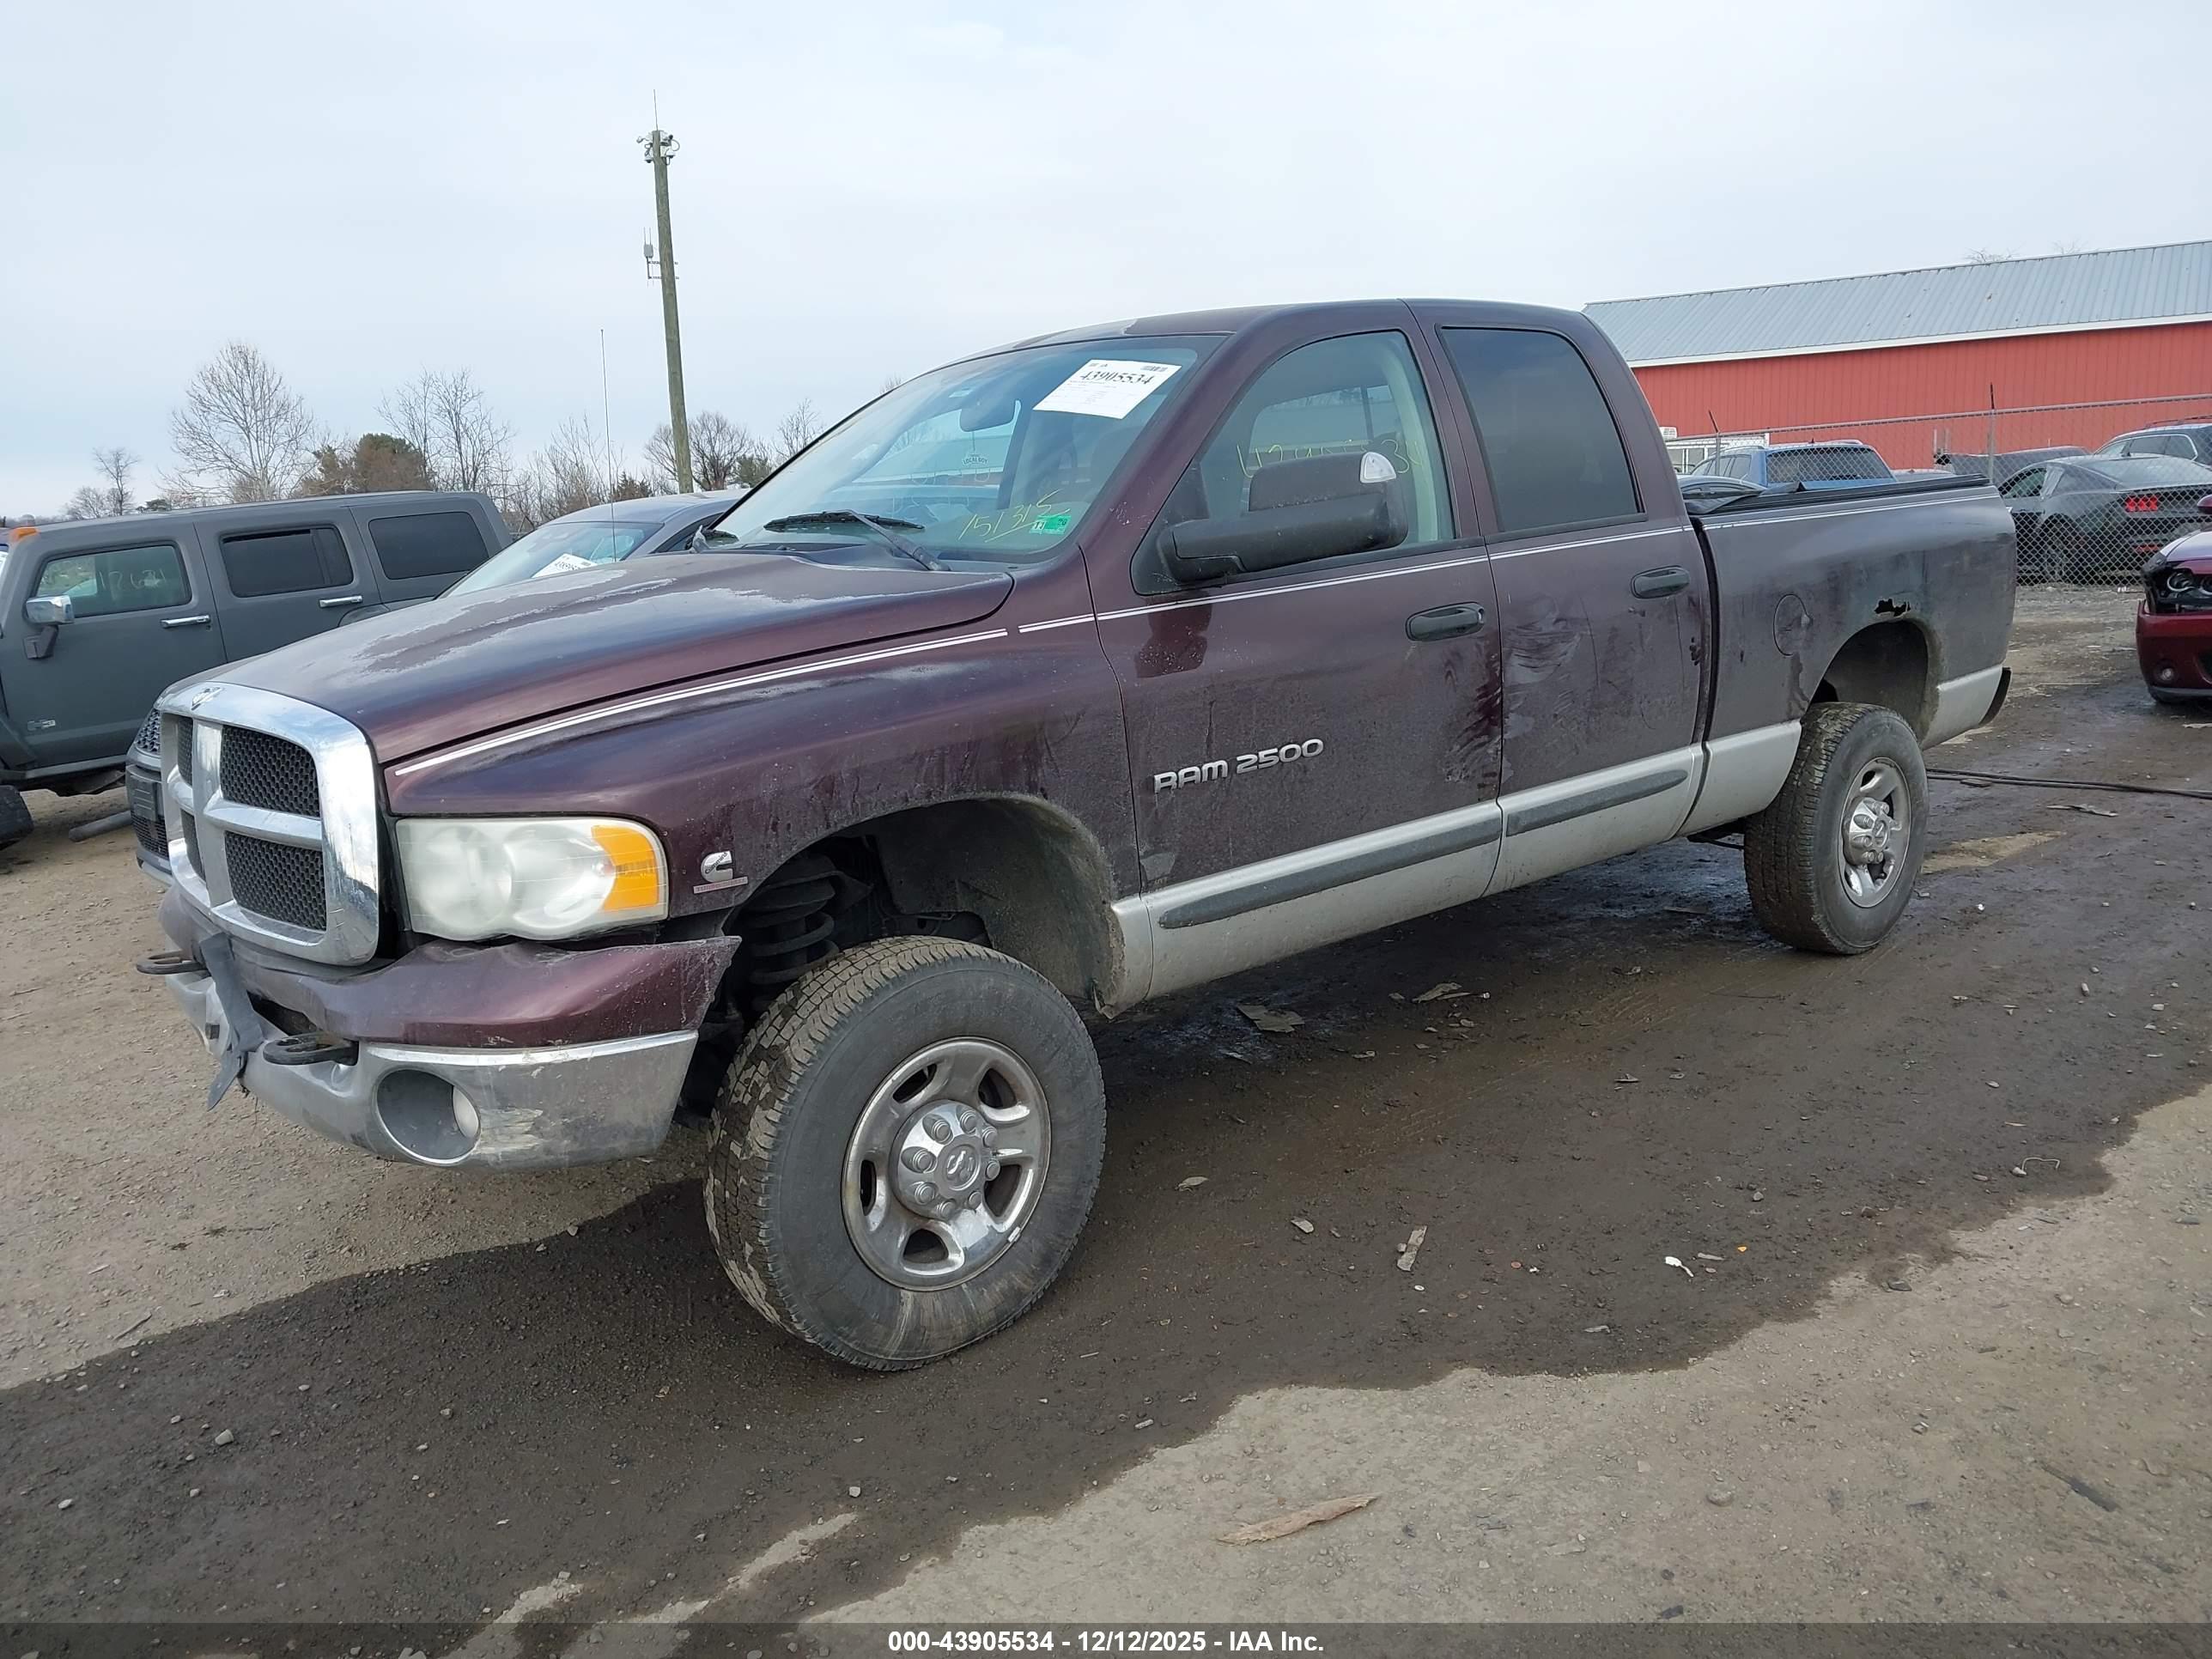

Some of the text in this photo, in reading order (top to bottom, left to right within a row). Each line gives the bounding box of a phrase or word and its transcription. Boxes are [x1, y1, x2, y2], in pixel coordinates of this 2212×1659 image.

[1079, 370, 1155, 385] 43905534
[1153, 738, 1324, 794] RAM 2500
